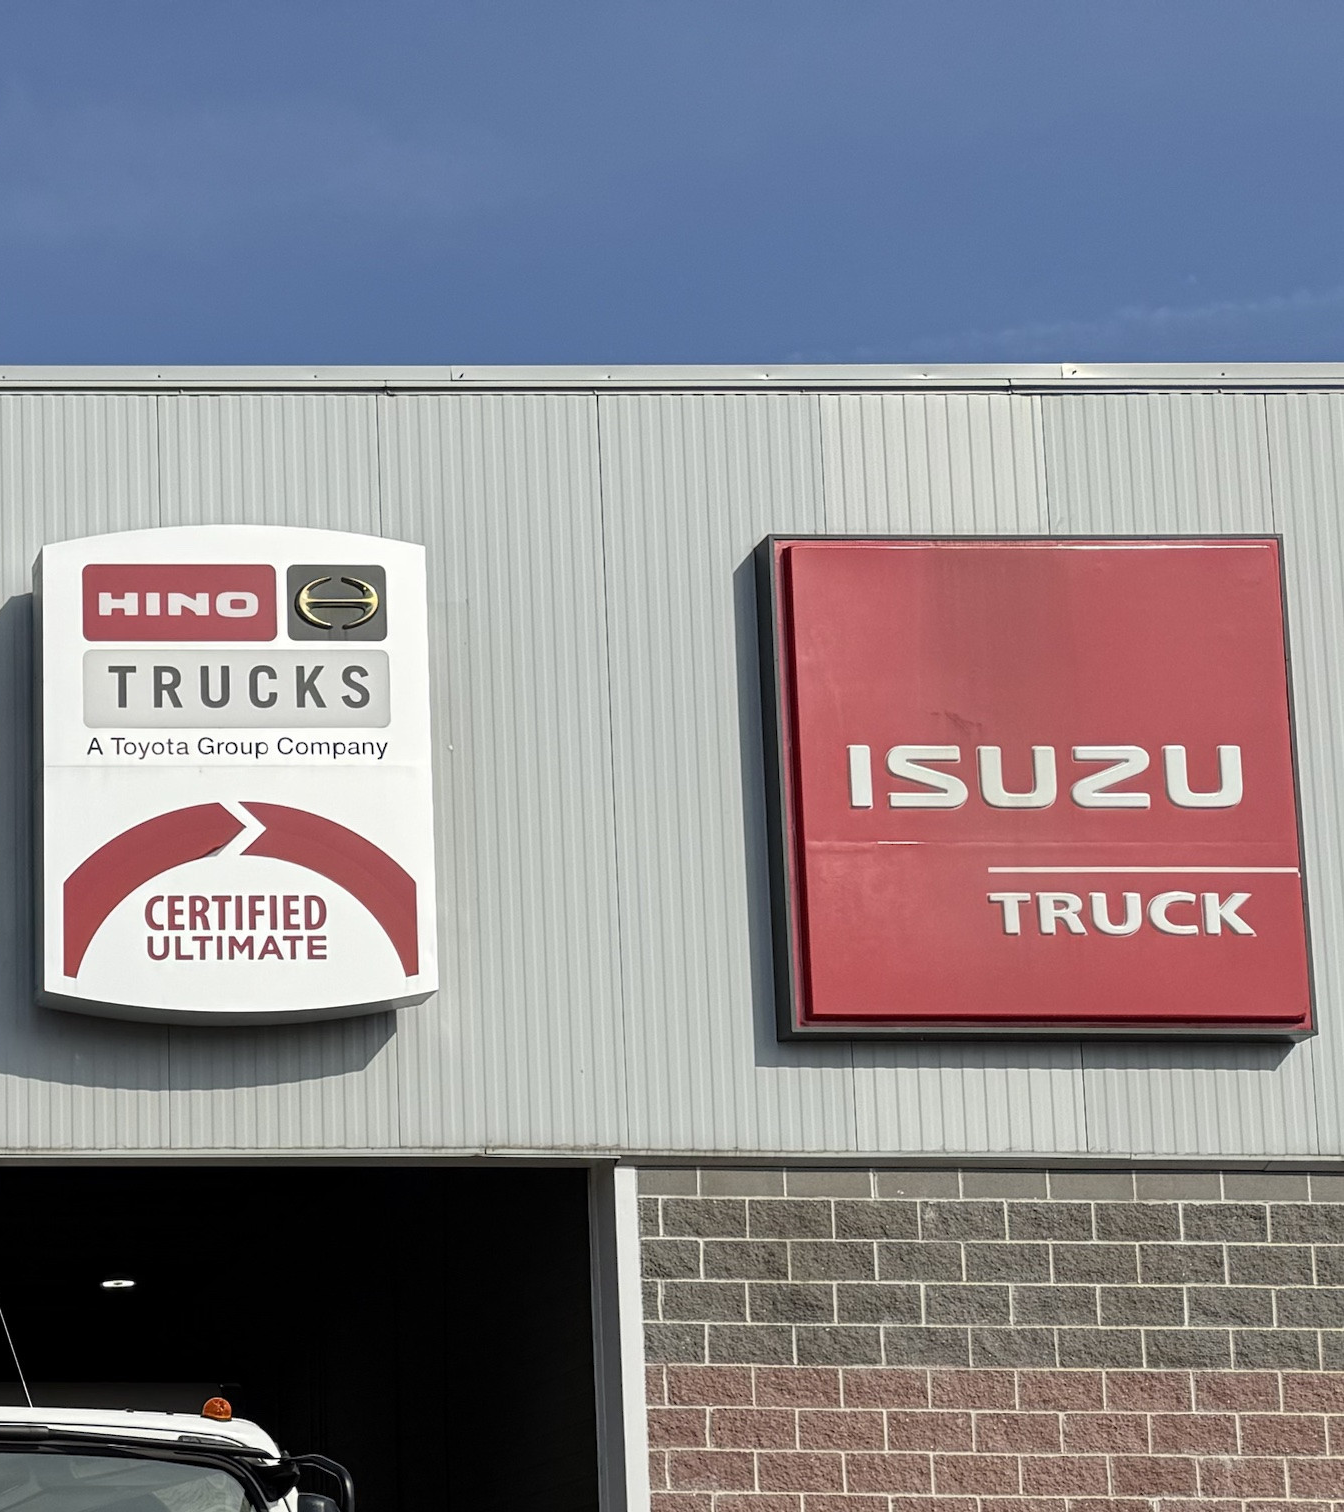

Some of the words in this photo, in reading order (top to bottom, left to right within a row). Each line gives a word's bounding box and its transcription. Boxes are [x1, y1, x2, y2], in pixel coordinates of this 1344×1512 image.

[98, 591, 259, 618] HINO
[107, 664, 371, 709] TRUCKS
[86, 737, 104, 756] A
[110, 736, 190, 760] Toyota
[197, 736, 269, 760] Group
[276, 736, 389, 760] Company
[845, 743, 1245, 811] ISUZU
[144, 894, 328, 931] CERTIFIED
[986, 889, 1257, 938] TRUCK
[146, 935, 328, 961] ULTIMATE
